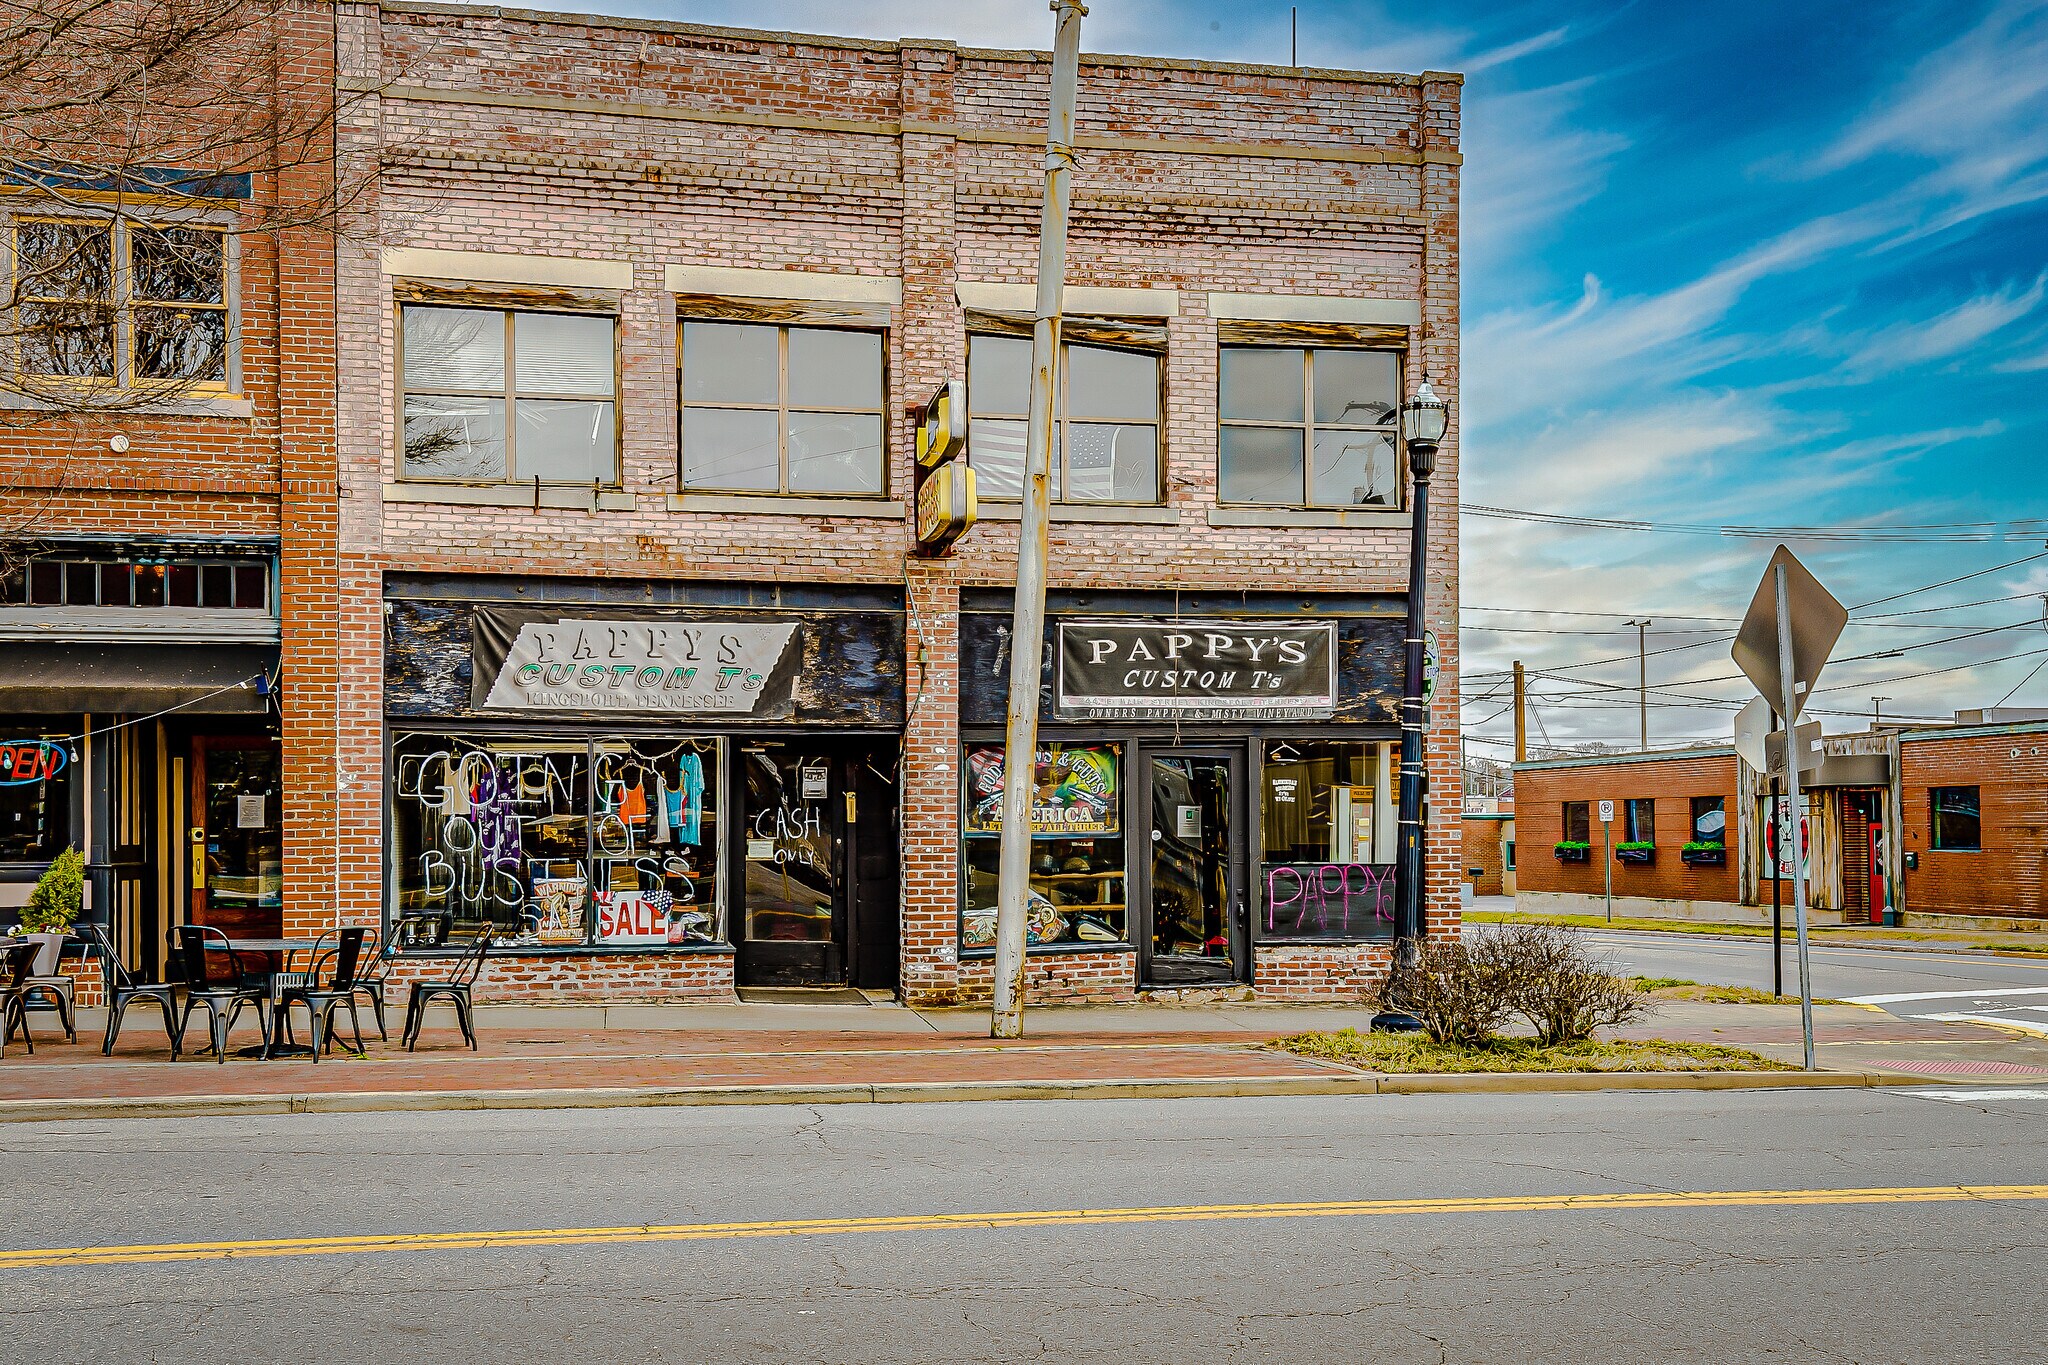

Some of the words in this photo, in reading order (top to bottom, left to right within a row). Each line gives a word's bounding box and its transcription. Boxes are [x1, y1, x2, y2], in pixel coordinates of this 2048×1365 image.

[1087, 633, 1307, 665] PAPPY'S
[514, 663, 699, 690] CUSTOM
[715, 667, 763, 692] T's
[1123, 669, 1237, 689] CUSTOM
[1251, 671, 1282, 689] T's
[1089, 708, 1137, 719] OWNERS
[1147, 709, 1185, 719] PAPPY
[1194, 709, 1204, 719] &
[1211, 709, 1246, 719] MISTY
[1255, 707, 1314, 719] VINEYARD
[0, 745, 58, 779] PEN
[1058, 752, 1070, 767] &
[1072, 758, 1108, 794] GUTS
[755, 806, 821, 840] CASH
[993, 806, 1094, 823] AERICA
[1046, 822, 1065, 832] ALL
[1067, 822, 1105, 831] THREE
[444, 815, 537, 860] OUT
[599, 814, 651, 855] OF
[774, 848, 814, 869] ONLY
[419, 850, 694, 905] BUSINESS
[600, 901, 666, 937] SALE
